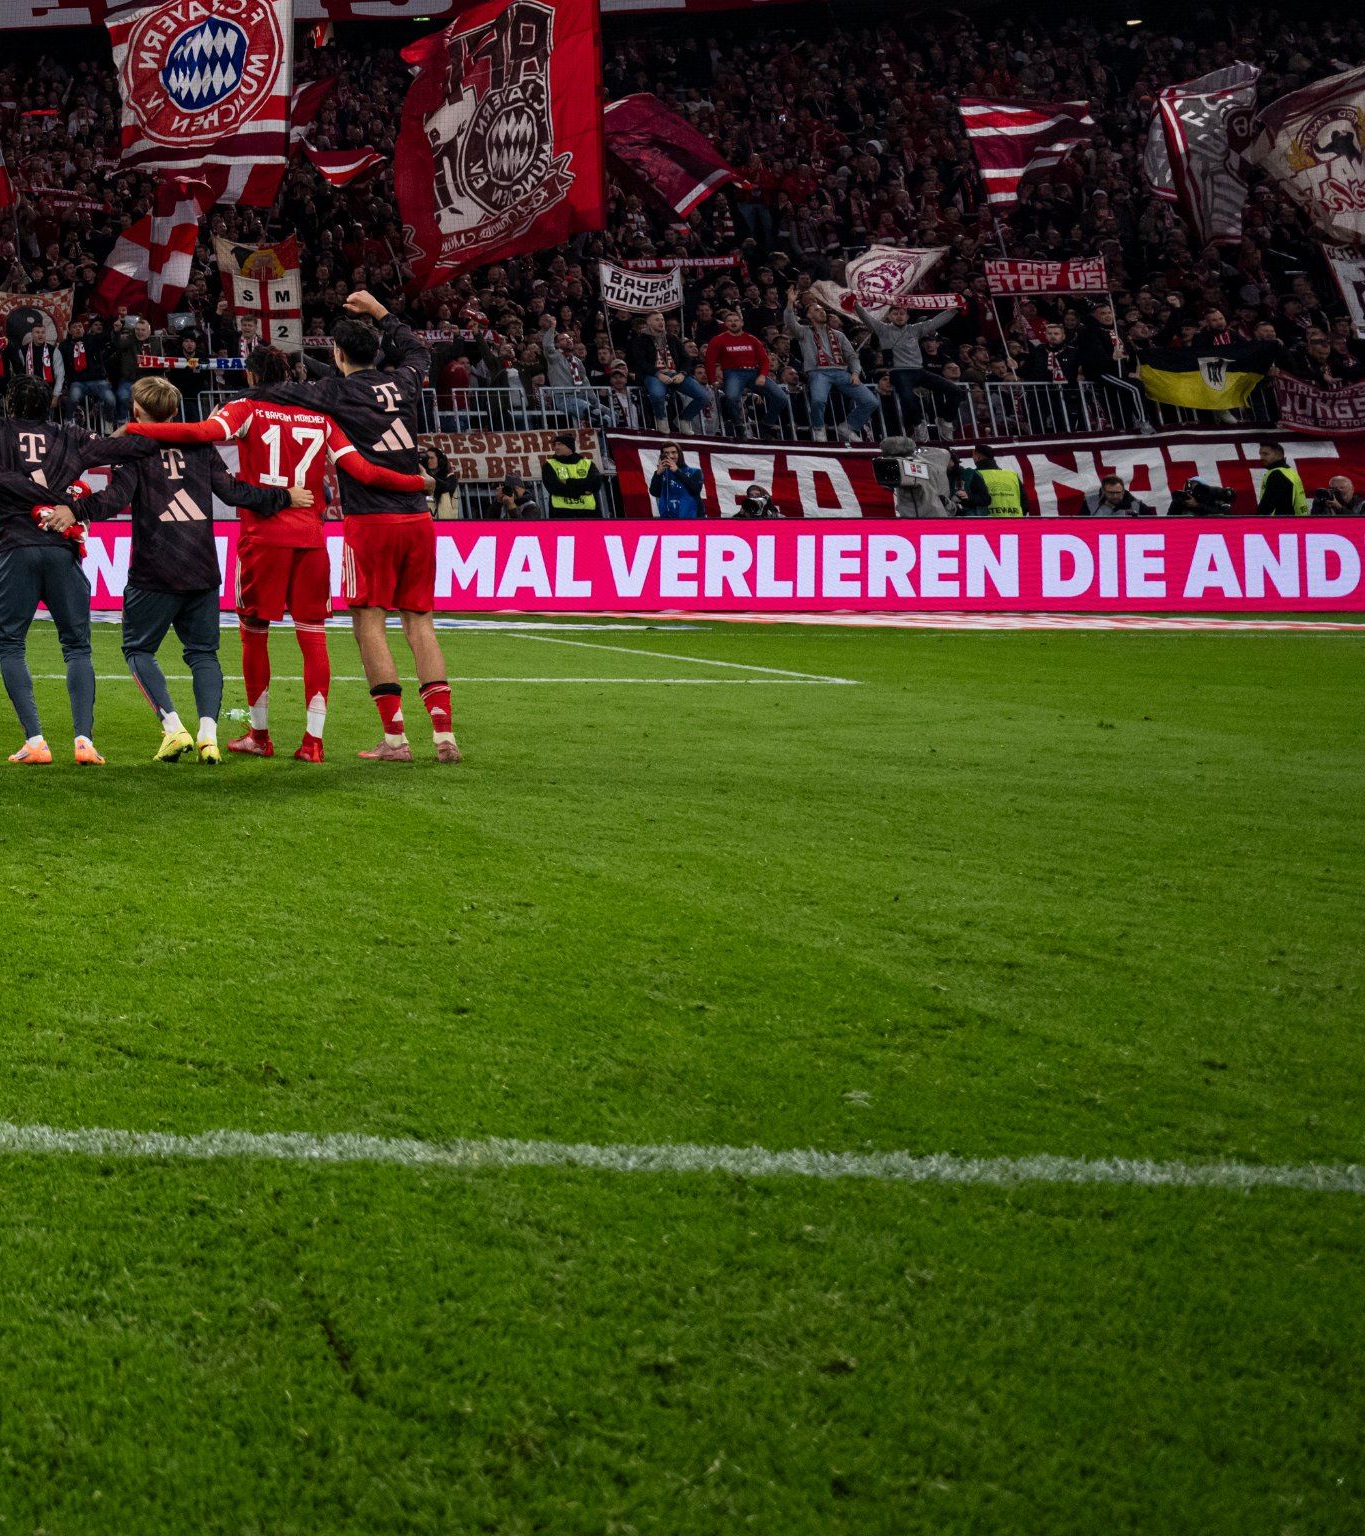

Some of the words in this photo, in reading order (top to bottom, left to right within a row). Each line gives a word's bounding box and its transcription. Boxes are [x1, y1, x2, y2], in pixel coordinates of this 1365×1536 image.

[985, 260, 1009, 274] NO
[989, 274, 1058, 292] STOP
[1068, 271, 1108, 291] US!
[243, 290, 253, 302] S
[275, 290, 290, 303] M
[604, 284, 679, 307] MÜNCHEN
[277, 326, 289, 338] 2
[372, 382, 401, 412] T
[19, 432, 46, 463] T
[259, 425, 324, 488] 17
[160, 448, 186, 479] T
[434, 535, 592, 598] MAL
[604, 534, 1019, 598] VERLIEREN
[1041, 533, 1166, 598] DIE
[1183, 533, 1361, 598] AND
